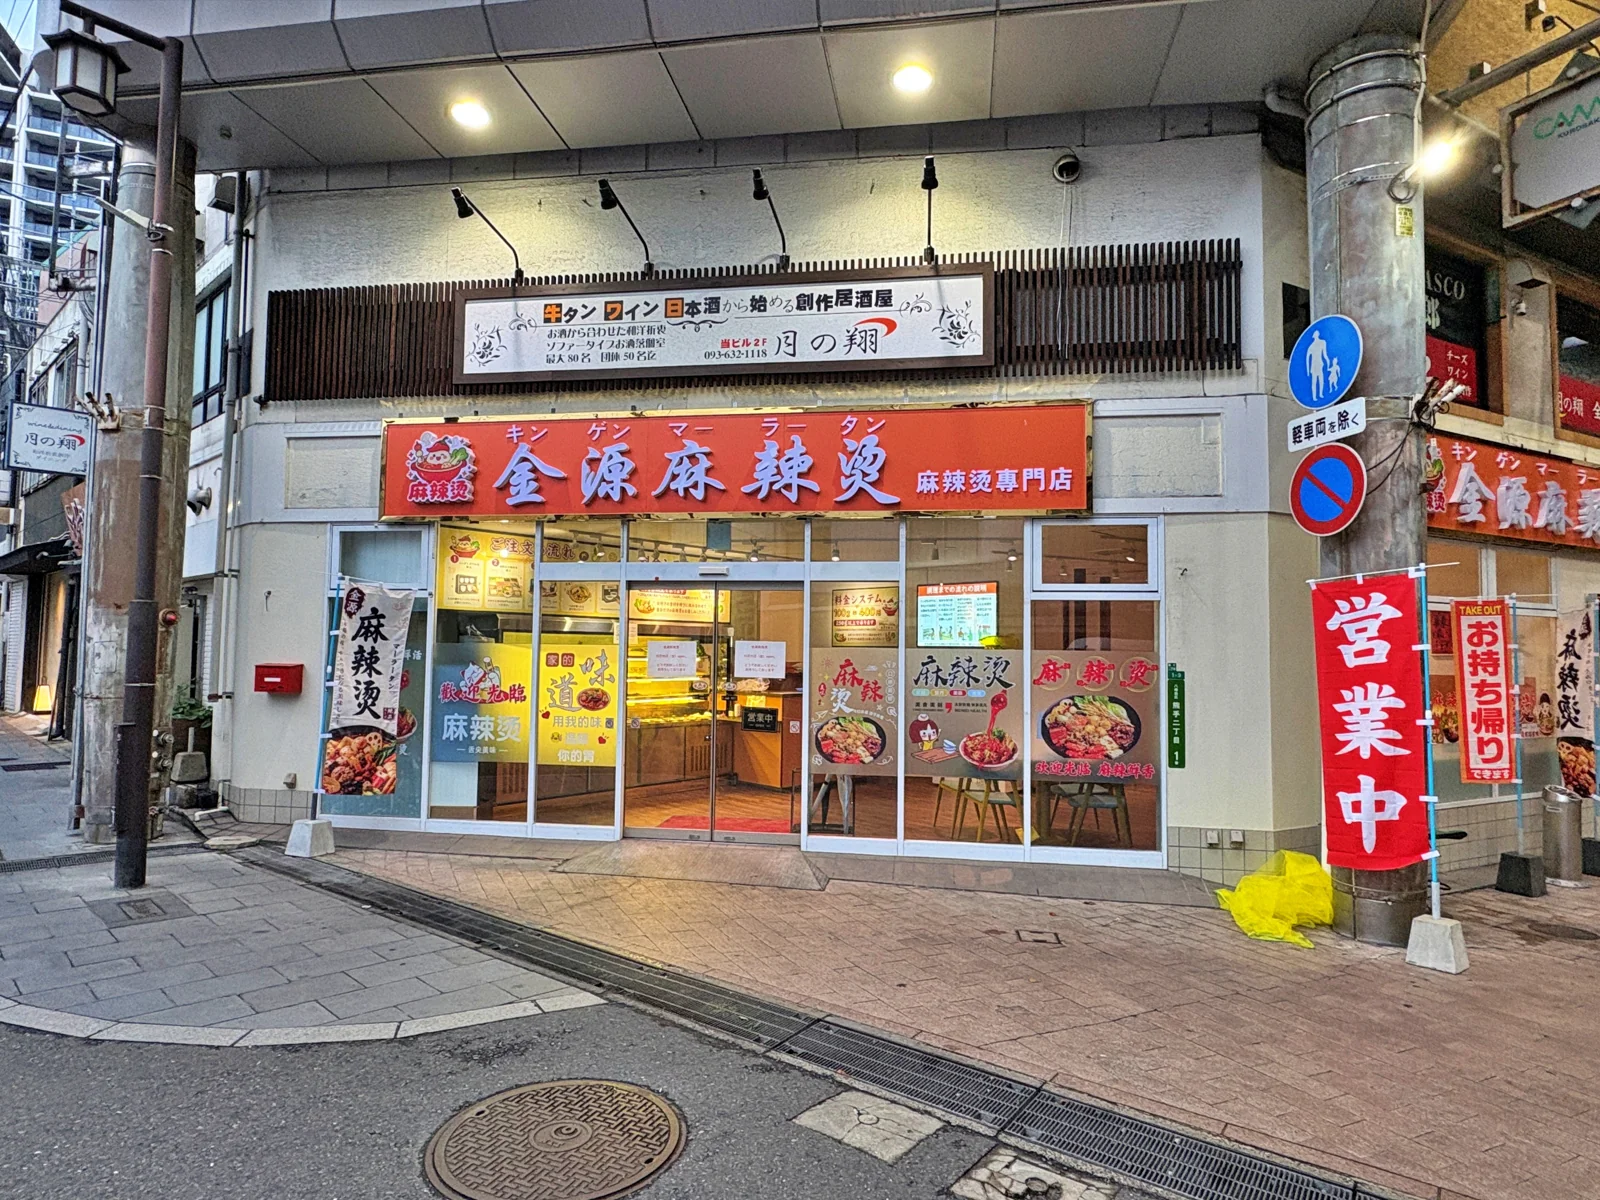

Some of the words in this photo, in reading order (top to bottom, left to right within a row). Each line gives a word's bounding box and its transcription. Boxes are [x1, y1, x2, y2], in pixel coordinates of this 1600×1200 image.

[544, 303, 597, 324] 牛タン
[604, 300, 659, 321] ワイン
[665, 289, 893, 319] 日本酒から始める創作居酒屋
[704, 349, 767, 360] 093-632-1118
[775, 328, 878, 358] 月の翔
[1447, 350, 1468, 366] チーズ
[1447, 366, 1468, 380] ワイン
[24, 432, 77, 451] 月の翔
[506, 423, 549, 444] キン
[587, 421, 631, 441] ゲン
[669, 421, 714, 437] マー
[761, 417, 807, 437] ラー
[841, 415, 886, 436] タン
[1292, 409, 1359, 446] 軽車両を除く
[1451, 441, 1478, 462] キン
[1496, 451, 1521, 470] ゲン
[1536, 462, 1560, 476] マー
[490, 537, 576, 559] ご注文流れ
[1459, 605, 1482, 615] TAKE
[1484, 605, 1502, 614] OUT
[351, 606, 390, 720] 麻辣烫
[388, 643, 401, 690] マーラータン
[1467, 620, 1504, 764] お持ち帰り
[442, 712, 521, 743] 麻辣烫
[747, 712, 774, 724] 営業中
[1326, 592, 1411, 854] 営業中
[1470, 768, 1510, 780] できます
